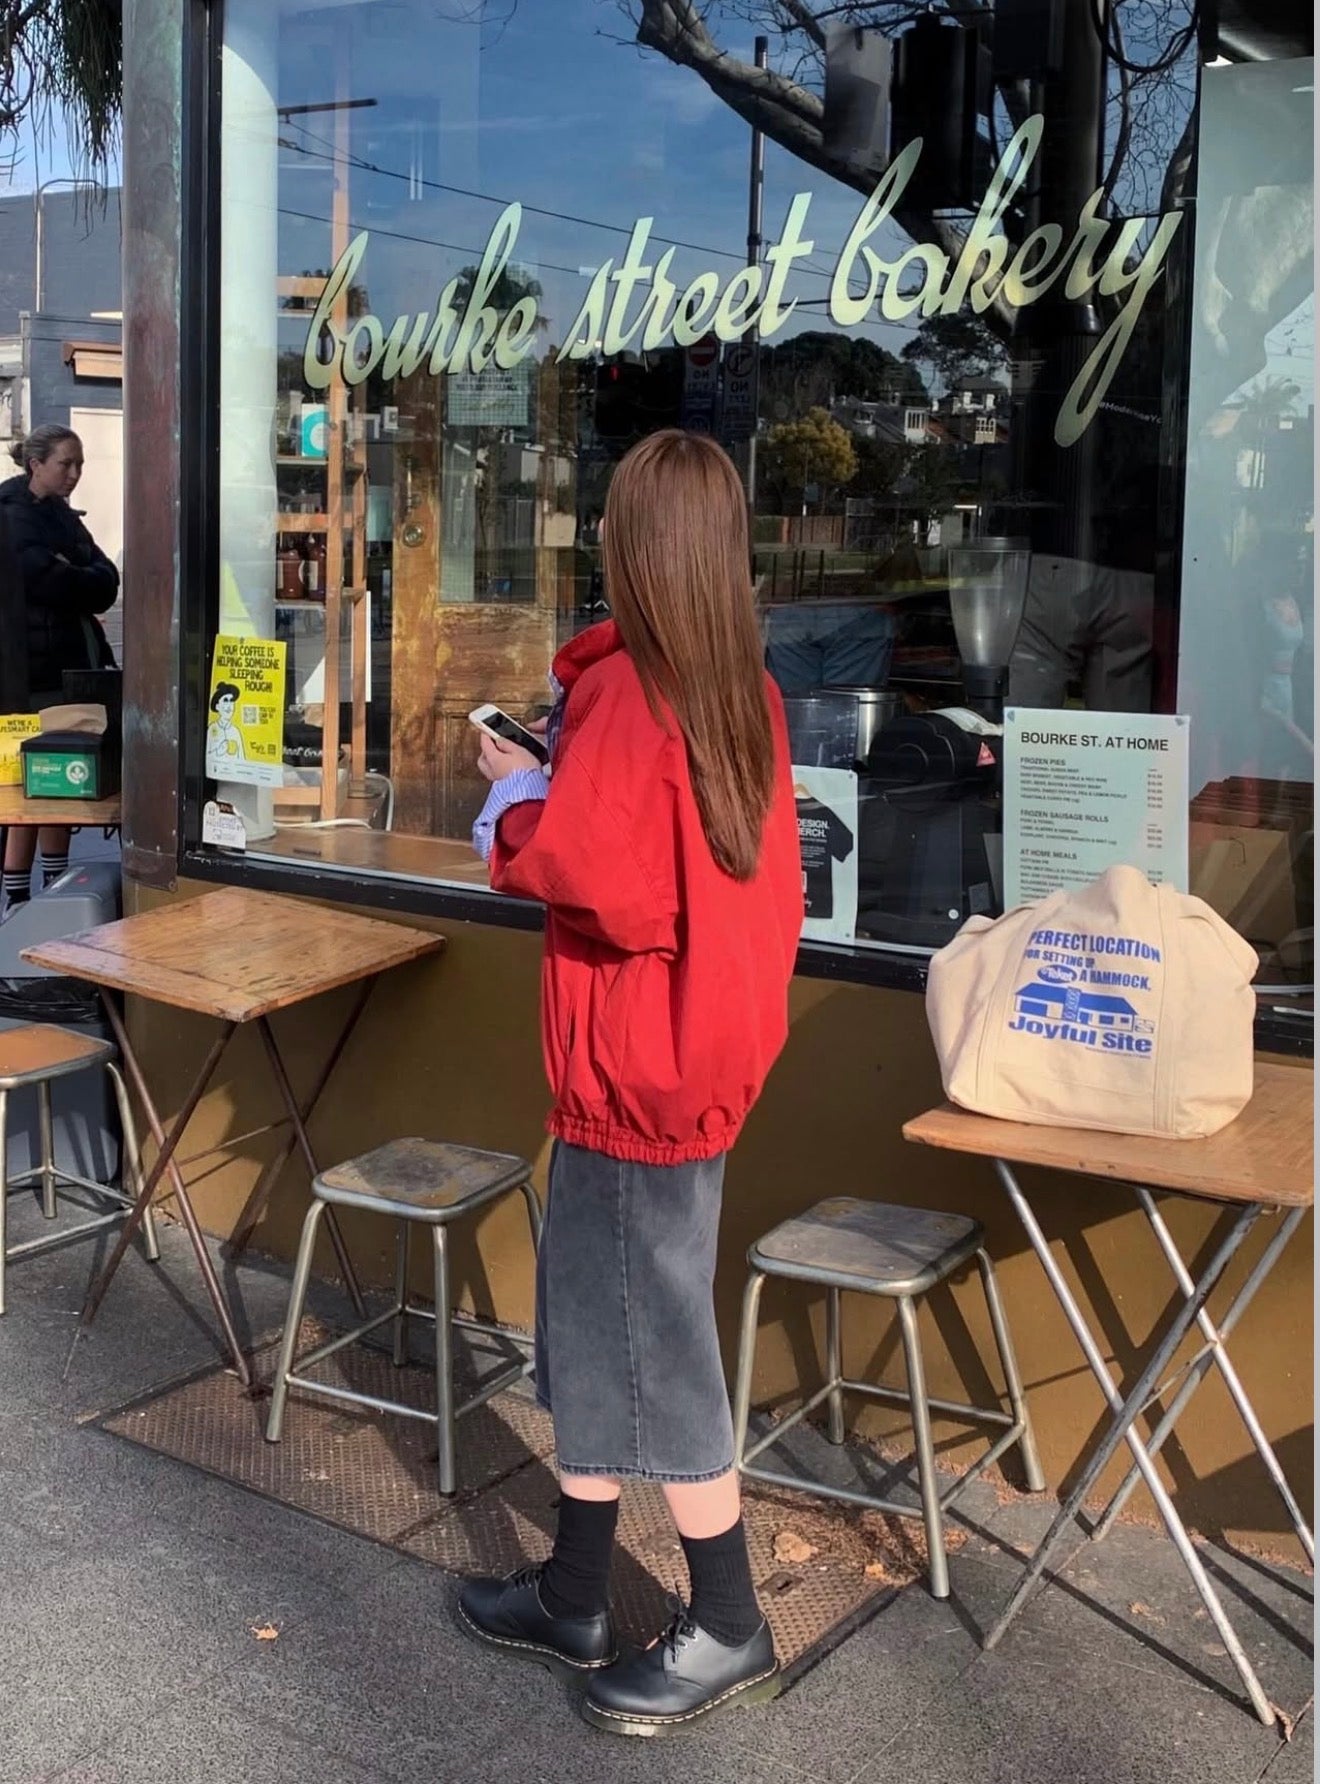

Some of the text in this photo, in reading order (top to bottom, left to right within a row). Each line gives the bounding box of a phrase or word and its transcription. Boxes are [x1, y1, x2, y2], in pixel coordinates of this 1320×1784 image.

[303, 113, 1184, 448] bourke street bakery
[222, 644, 274, 658] YOUR COFFEE IS
[216, 656, 280, 670] HELPING SOMEONE
[229, 668, 264, 680] SLEEPING
[1020, 732, 1169, 751] BOURKE ST. AT HOME
[1020, 757, 1049, 766] FROZEN
[1020, 810, 1049, 819] FROZEN
[1050, 812, 1084, 822] SAUSAGE
[1085, 814, 1109, 823] ROLLS
[798, 828, 827, 838] ERCH.
[1020, 848, 1078, 860] AT HOME MEALS
[1028, 930, 1161, 963] PERFECT LOCATION
[1042, 950, 1084, 967] SETTING
[1079, 970, 1088, 982] A
[1090, 970, 1152, 991] HAMMOCK.
[1008, 1016, 1096, 1045] Joyful
[1102, 1032, 1153, 1053] Site
